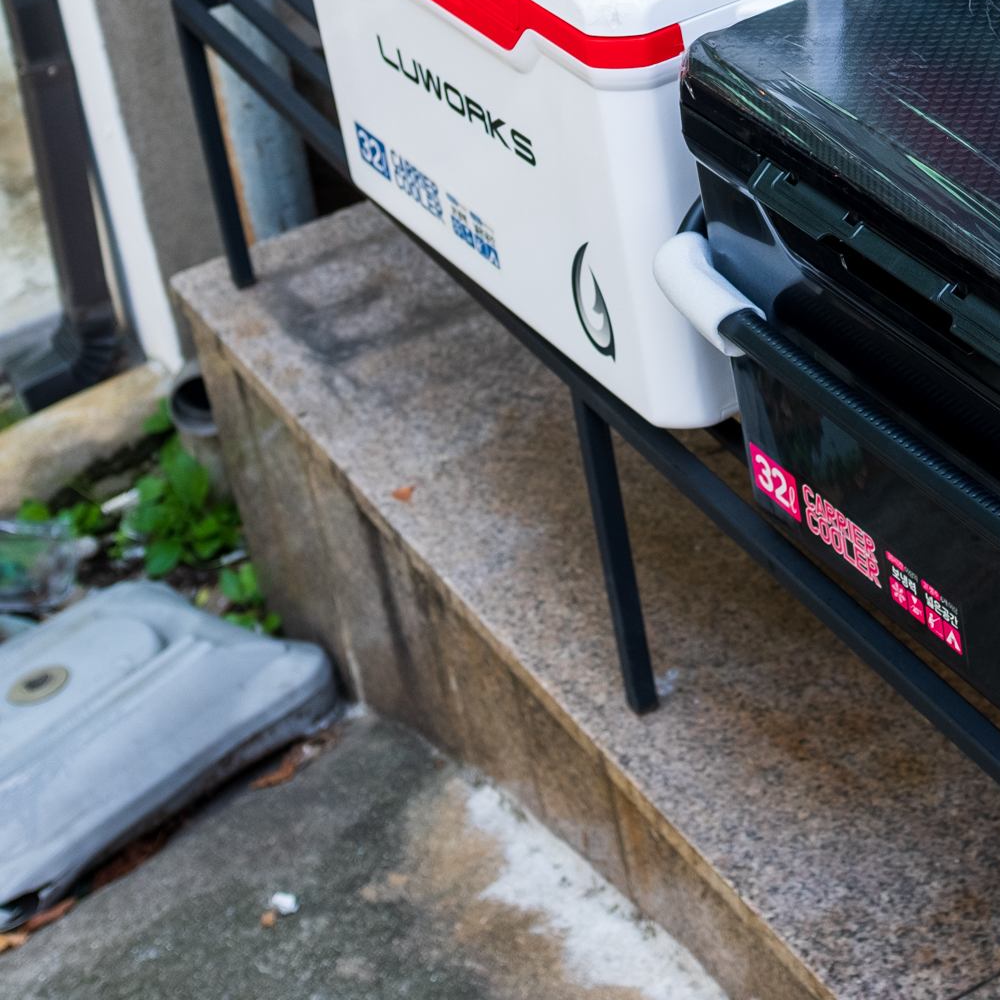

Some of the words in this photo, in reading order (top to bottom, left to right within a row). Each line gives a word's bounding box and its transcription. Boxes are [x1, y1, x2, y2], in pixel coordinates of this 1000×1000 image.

[376, 34, 537, 167] LUWORKS
[802, 484, 876, 555] CARRIER
[805, 507, 882, 589] COOLER
